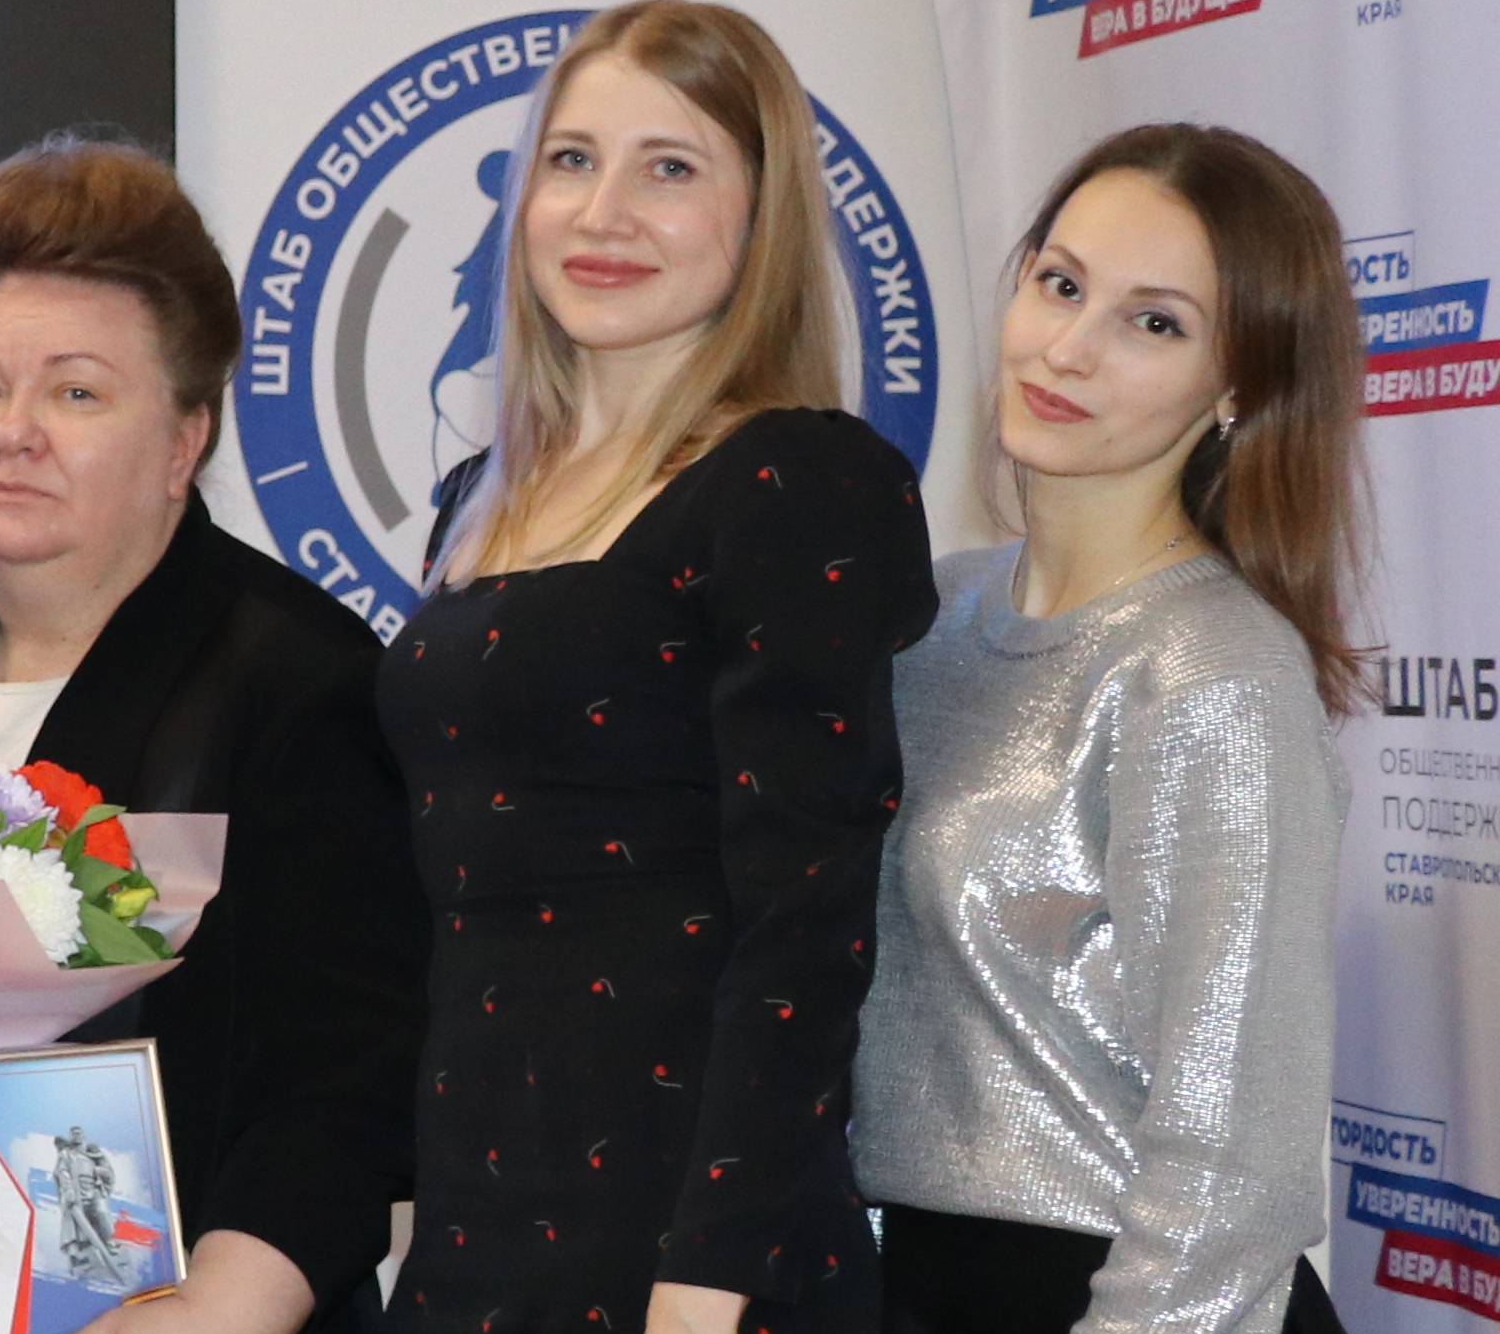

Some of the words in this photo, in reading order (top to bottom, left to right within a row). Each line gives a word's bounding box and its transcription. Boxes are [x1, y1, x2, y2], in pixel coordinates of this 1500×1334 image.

[1132, 0, 1148, 31] В
[251, 228, 312, 396] ШТАБ
[296, 24, 572, 221] ОБЩЕСТВЕ
[1365, 368, 1422, 405] ВЕРА
[1438, 358, 1500, 399] БУДУ
[1381, 657, 1499, 720] ШТАБ
[1386, 882, 1435, 908] КРАЯ
[1387, 1247, 1454, 1291] ВЕРА
[1458, 1263, 1470, 1294] В
